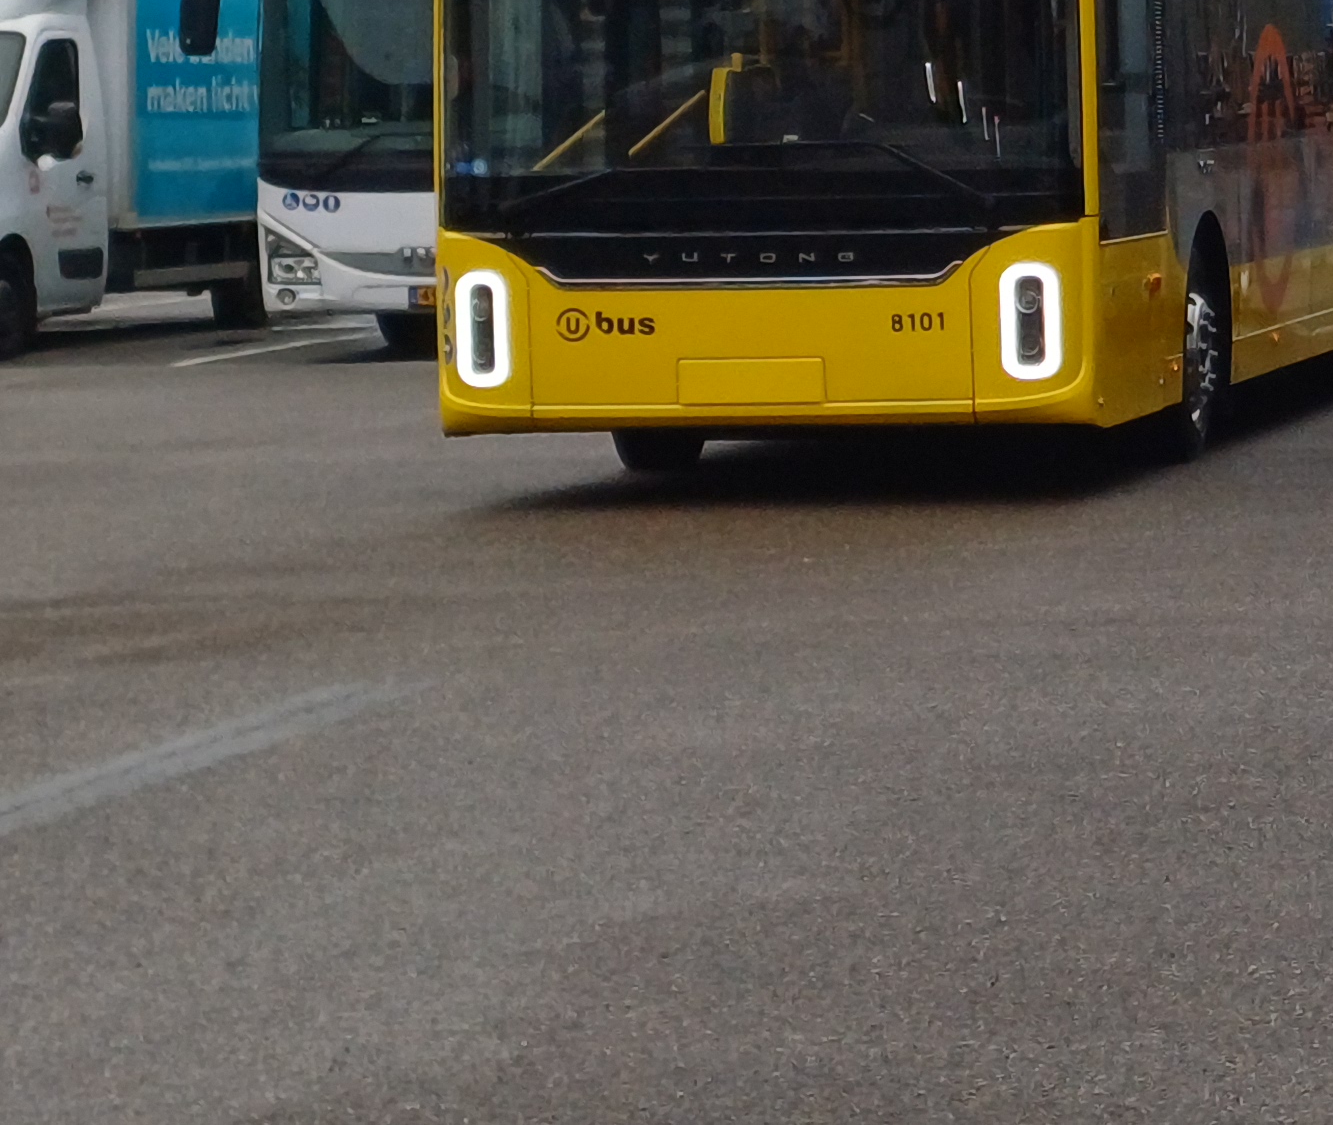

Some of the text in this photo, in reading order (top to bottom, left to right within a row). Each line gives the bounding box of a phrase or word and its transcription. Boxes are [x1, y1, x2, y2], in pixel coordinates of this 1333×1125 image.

[146, 76, 207, 113] maken
[211, 75, 250, 113] licht
[643, 251, 855, 263] YUTONG
[595, 310, 656, 336] bus
[890, 311, 946, 333] 8101
